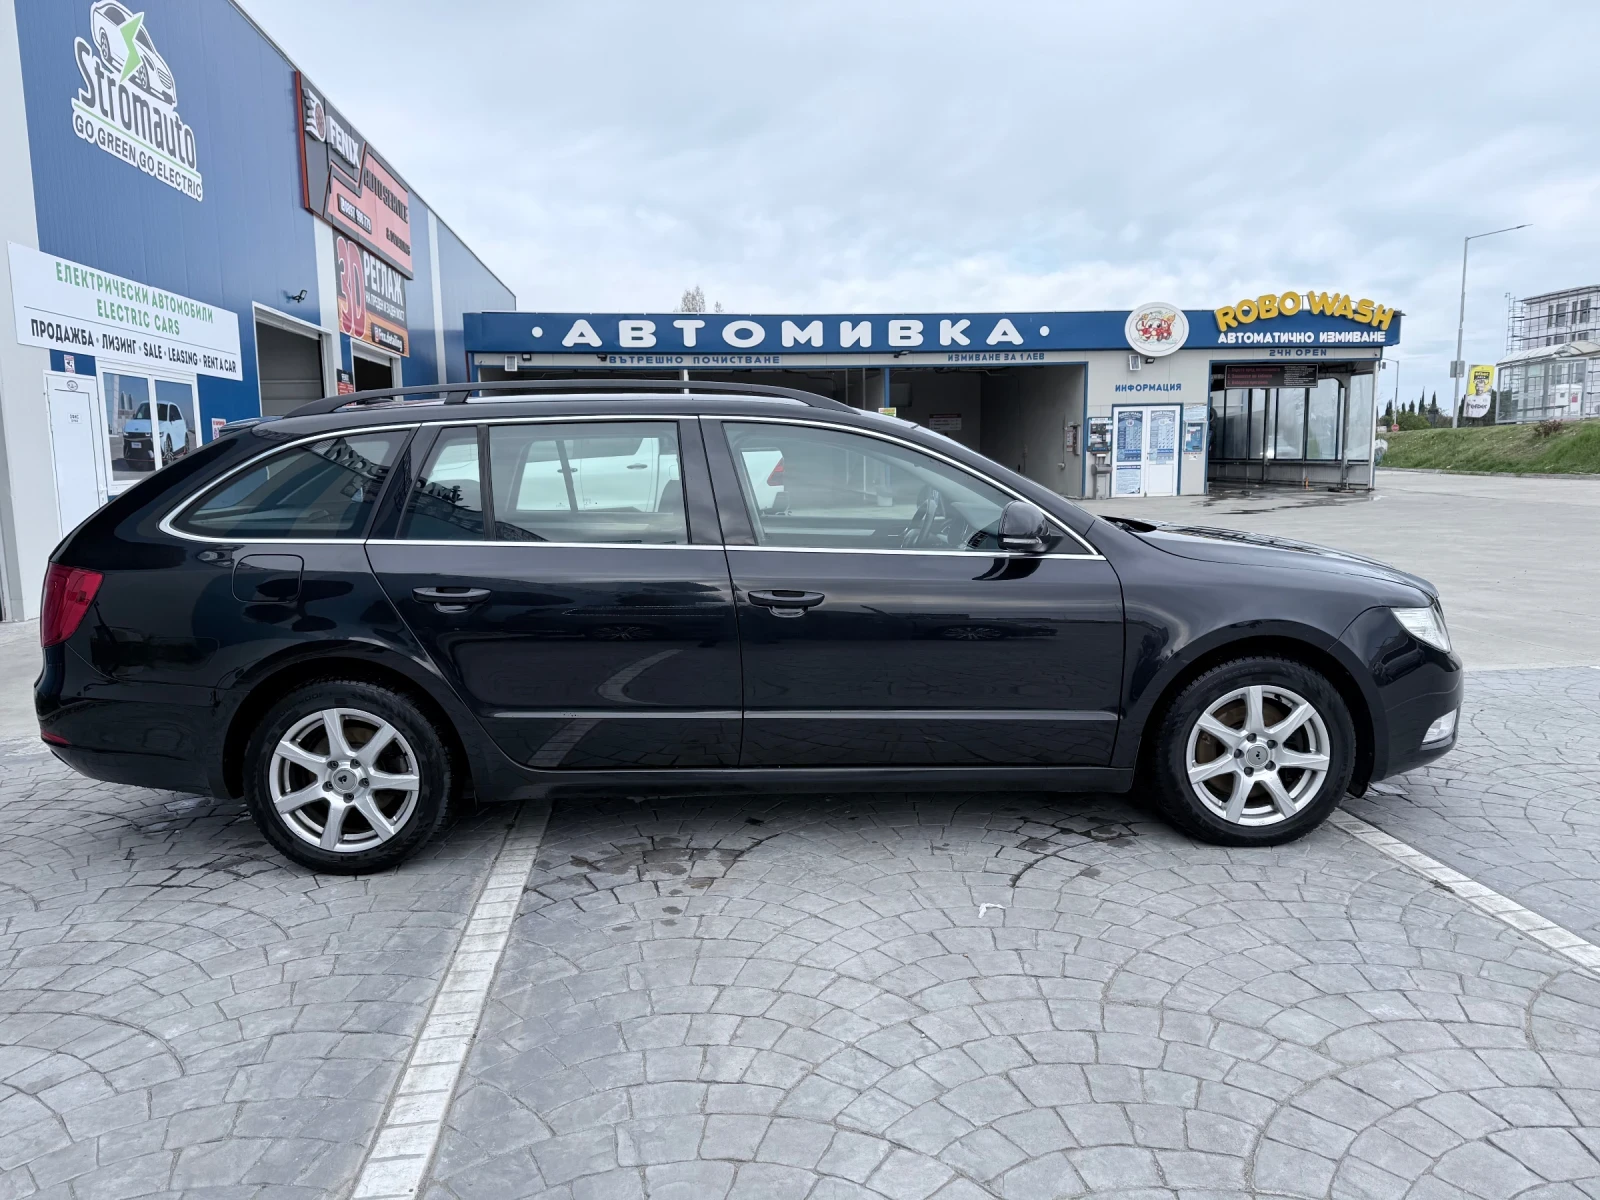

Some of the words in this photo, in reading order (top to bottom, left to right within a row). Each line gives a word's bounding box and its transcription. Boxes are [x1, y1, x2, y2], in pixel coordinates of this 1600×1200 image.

[76, 39, 196, 169] Stromauto
[75, 114, 94, 139] GO
[97, 127, 136, 163] GREEN
[139, 150, 155, 172] GO
[156, 160, 202, 198] ELECTRIC
[326, 115, 360, 169] FENIX
[55, 261, 149, 306] ЕЛЕКТРИЧЕСКИ
[151, 289, 214, 324] АВТОМОБИЛИ
[363, 250, 404, 307] РЕГЛАЖ
[96, 299, 150, 328] ELECTRIC
[154, 315, 180, 336] CARS
[1214, 291, 1302, 332] ROBO
[1307, 290, 1396, 331] WASH
[30, 318, 95, 348] ПРОДАЖБА
[101, 333, 137, 355] ЛИЗИНГ
[143, 342, 163, 360] SALE
[167, 350, 198, 367] LEASING
[202, 354, 219, 370] RENT
[224, 360, 237, 373] CAR
[561, 318, 1024, 349] АВТОМИВКА
[1217, 331, 1315, 345] АВТОМАТИЧНО
[1319, 331, 1386, 343] ИЗМИВАНЕ
[1295, 349, 1327, 357] OPEN
[609, 356, 684, 364] ВЪТРЕШНО
[693, 355, 780, 364] ПОЧИСТВАНЕ
[947, 353, 1001, 362] ИЗМИВАНЕ
[1003, 353, 1017, 361] ЗА
[1026, 352, 1045, 361] ЛЕВ
[1115, 383, 1182, 392] ИНФОРМАЦИЯ
